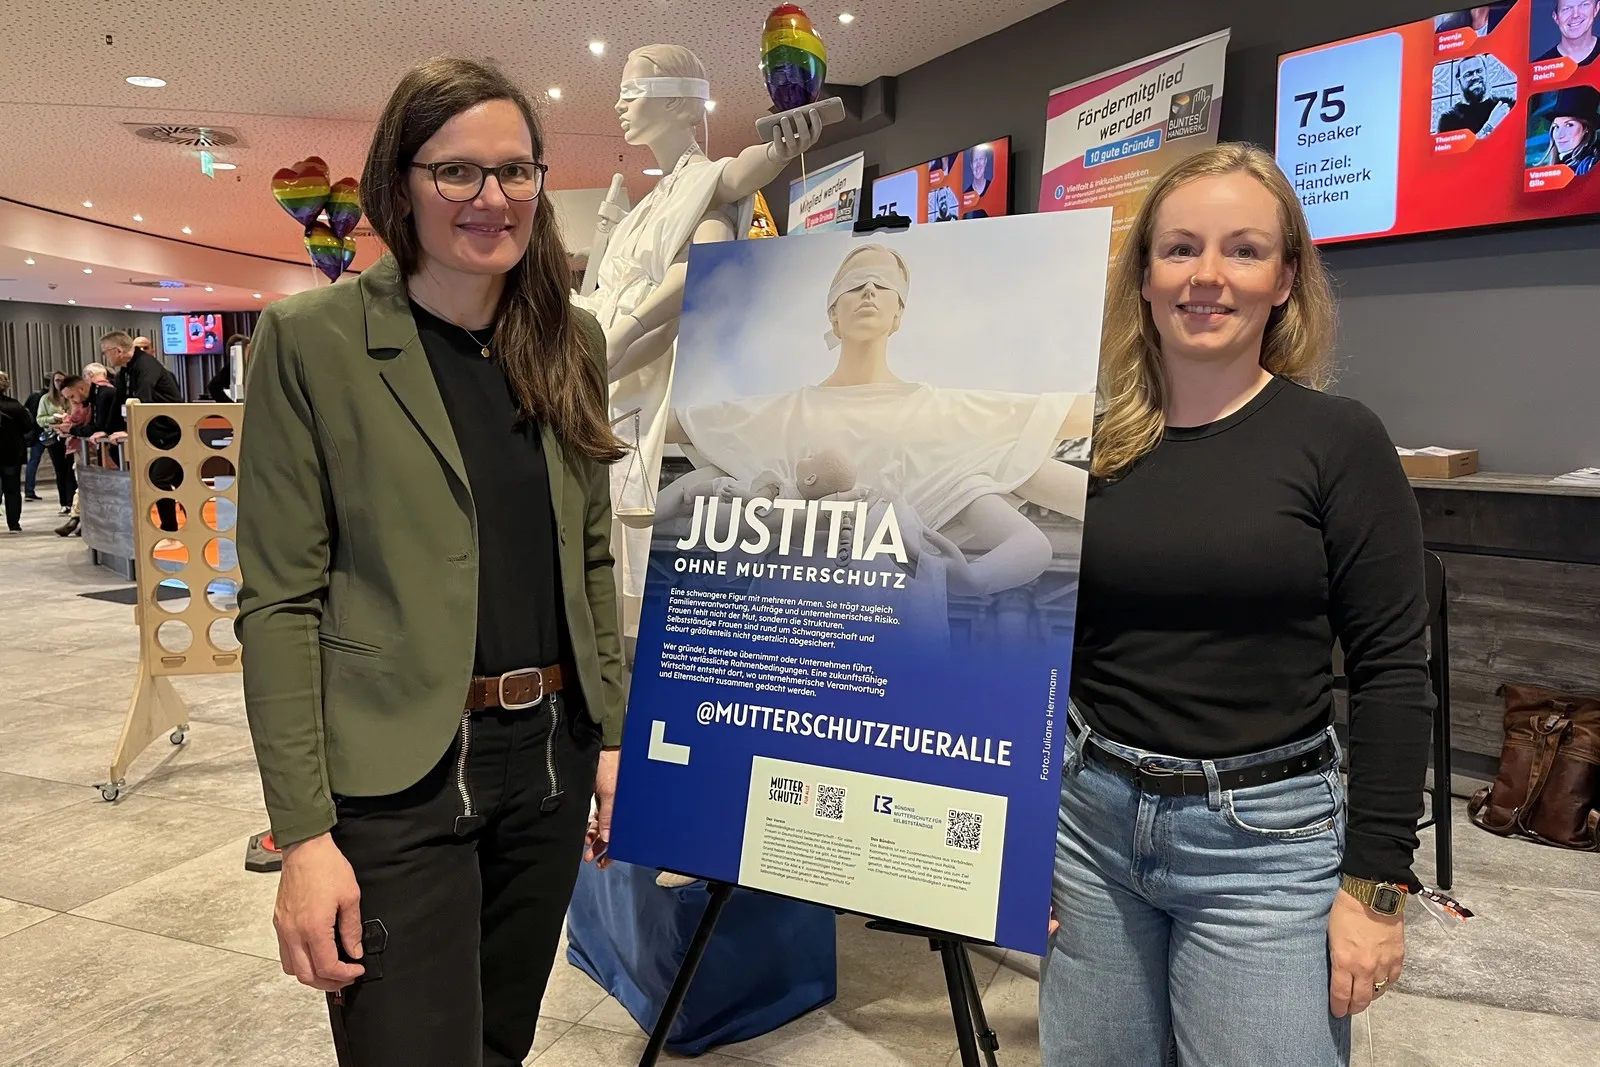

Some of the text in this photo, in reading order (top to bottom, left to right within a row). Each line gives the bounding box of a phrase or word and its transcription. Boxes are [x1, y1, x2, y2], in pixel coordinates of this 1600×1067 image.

[1438, 33, 1462, 43] Svenja
[1533, 61, 1564, 72] Thomas
[1533, 71, 1555, 81] Reich
[1077, 63, 1184, 130] Fördermitglied
[1294, 85, 1346, 128] 75
[1100, 107, 1151, 140] werden
[1169, 114, 1199, 130] BUNTES
[1297, 125, 1361, 147] Speaker
[1090, 136, 1155, 163] 10 gute Gründe
[1295, 155, 1351, 176] Ein Ziel:
[1295, 168, 1371, 191] Handwerk
[800, 189, 823, 214] Mitglied
[823, 178, 847, 199] werden
[1301, 190, 1349, 206] tärken
[677, 496, 914, 563] JUSTITIA
[675, 558, 906, 588] OHNE MUTTERSCHUTZ
[670, 597, 749, 612] Familienverantwortung,
[751, 605, 783, 615] Aufträge
[801, 610, 872, 622] unternehmerisches
[875, 615, 900, 624] Risiko.
[687, 590, 726, 600] schwangere
[729, 593, 747, 602] Figur
[762, 596, 796, 605] mehreren
[798, 599, 824, 607] Armen.
[826, 601, 837, 609] Sie
[840, 602, 859, 612] trägt
[861, 605, 893, 614] zugleich
[667, 615, 716, 627] Selbstständige
[718, 620, 742, 628] Frauen
[744, 622, 758, 630] sind
[792, 627, 857, 640] Schwangerschaft
[668, 606, 691, 614] Frauen
[693, 608, 708, 616] fehlt
[742, 613, 757, 622] Mut,
[790, 617, 801, 625] die
[803, 619, 844, 629] Strukturen.
[666, 624, 835, 648] Geburt größtenteils nicht gesetzlich abgesichert.
[662, 652, 887, 686] braucht verlässliche Rahmenbedingungen. Eine zukunftsfähige
[678, 645, 706, 654] gründet,
[709, 647, 738, 657] Betriebe
[740, 651, 779, 661] übernimmt
[800, 658, 850, 670] Unternehmen
[853, 663, 873, 674] führt,
[661, 661, 696, 671] Wirtschaft
[727, 669, 744, 678] dort,
[758, 674, 824, 687] unternehmerische
[827, 681, 884, 697] Verantwortung
[674, 672, 714, 683] Elternschaft
[716, 678, 753, 688] zusammen
[755, 683, 786, 692] gedacht
[788, 688, 816, 696] werden.
[1046, 668, 1058, 717] Herrmann
[697, 701, 1012, 766] @MUTTERSCHUTZFUERALLE
[769, 789, 802, 805] SCHUTZ!
[771, 777, 803, 793] MUTTER
[893, 818, 933, 829] SELBSTSTÄNDIGE
[894, 812, 931, 822] MUTTERSCHUTZ
